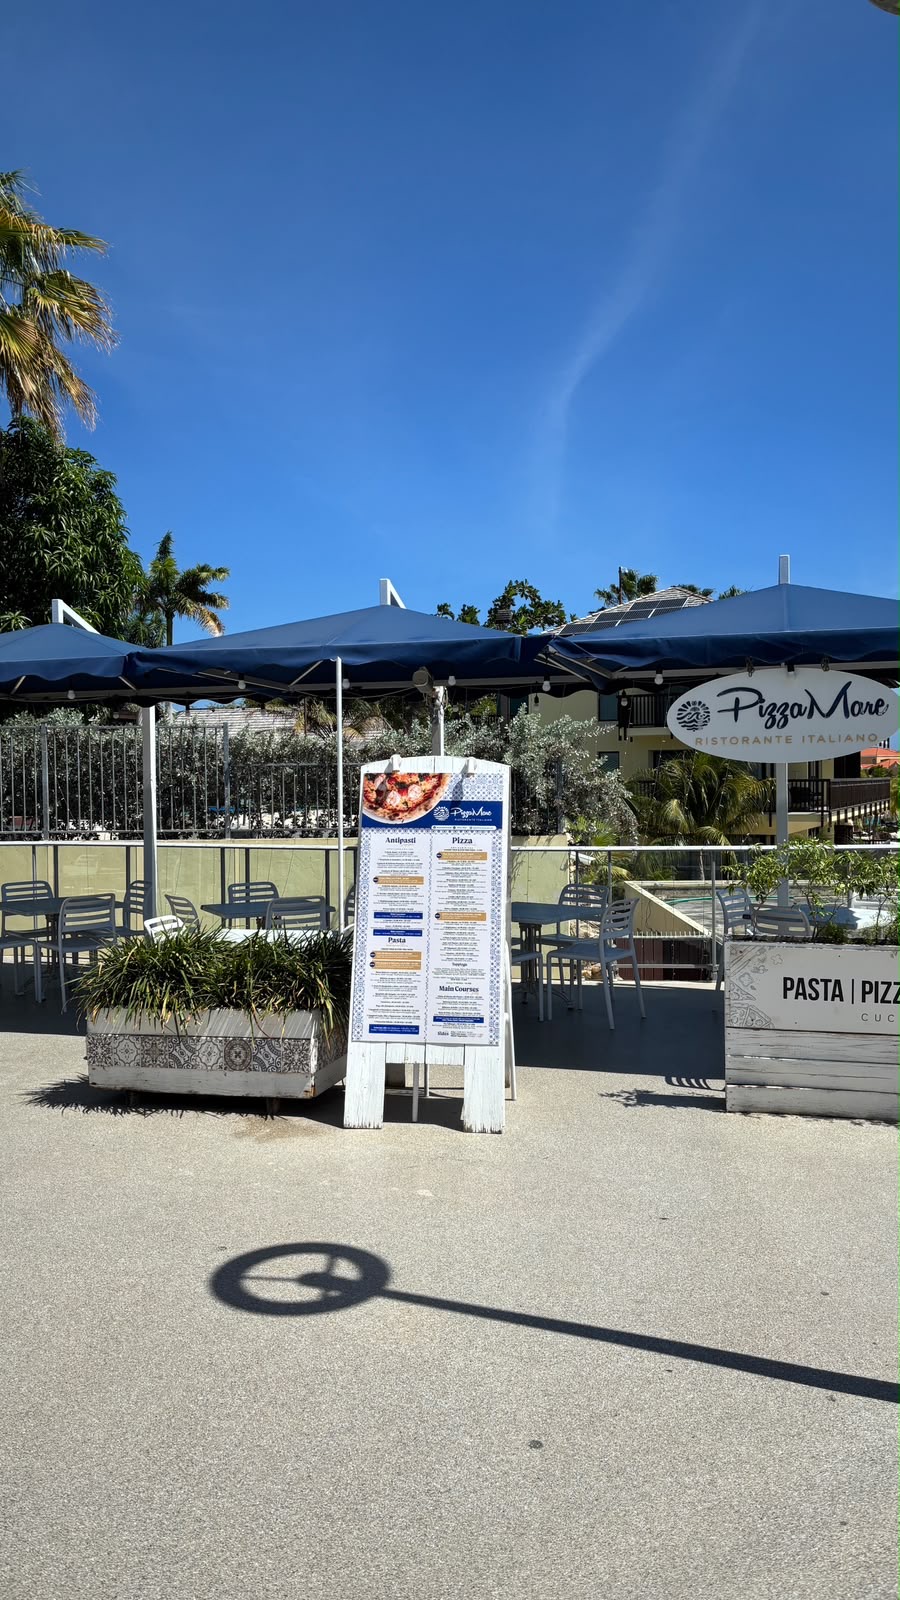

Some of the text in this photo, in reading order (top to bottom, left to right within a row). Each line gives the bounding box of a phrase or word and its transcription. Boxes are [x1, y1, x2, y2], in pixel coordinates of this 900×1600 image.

[695, 733, 878, 746] RISTORANTE ITALIANO
[385, 837, 416, 845] Antipasti
[452, 836, 473, 844] Pizza
[454, 985, 479, 993] Courses
[783, 977, 844, 1002] PASTA
[861, 1013, 895, 1022] CUC
